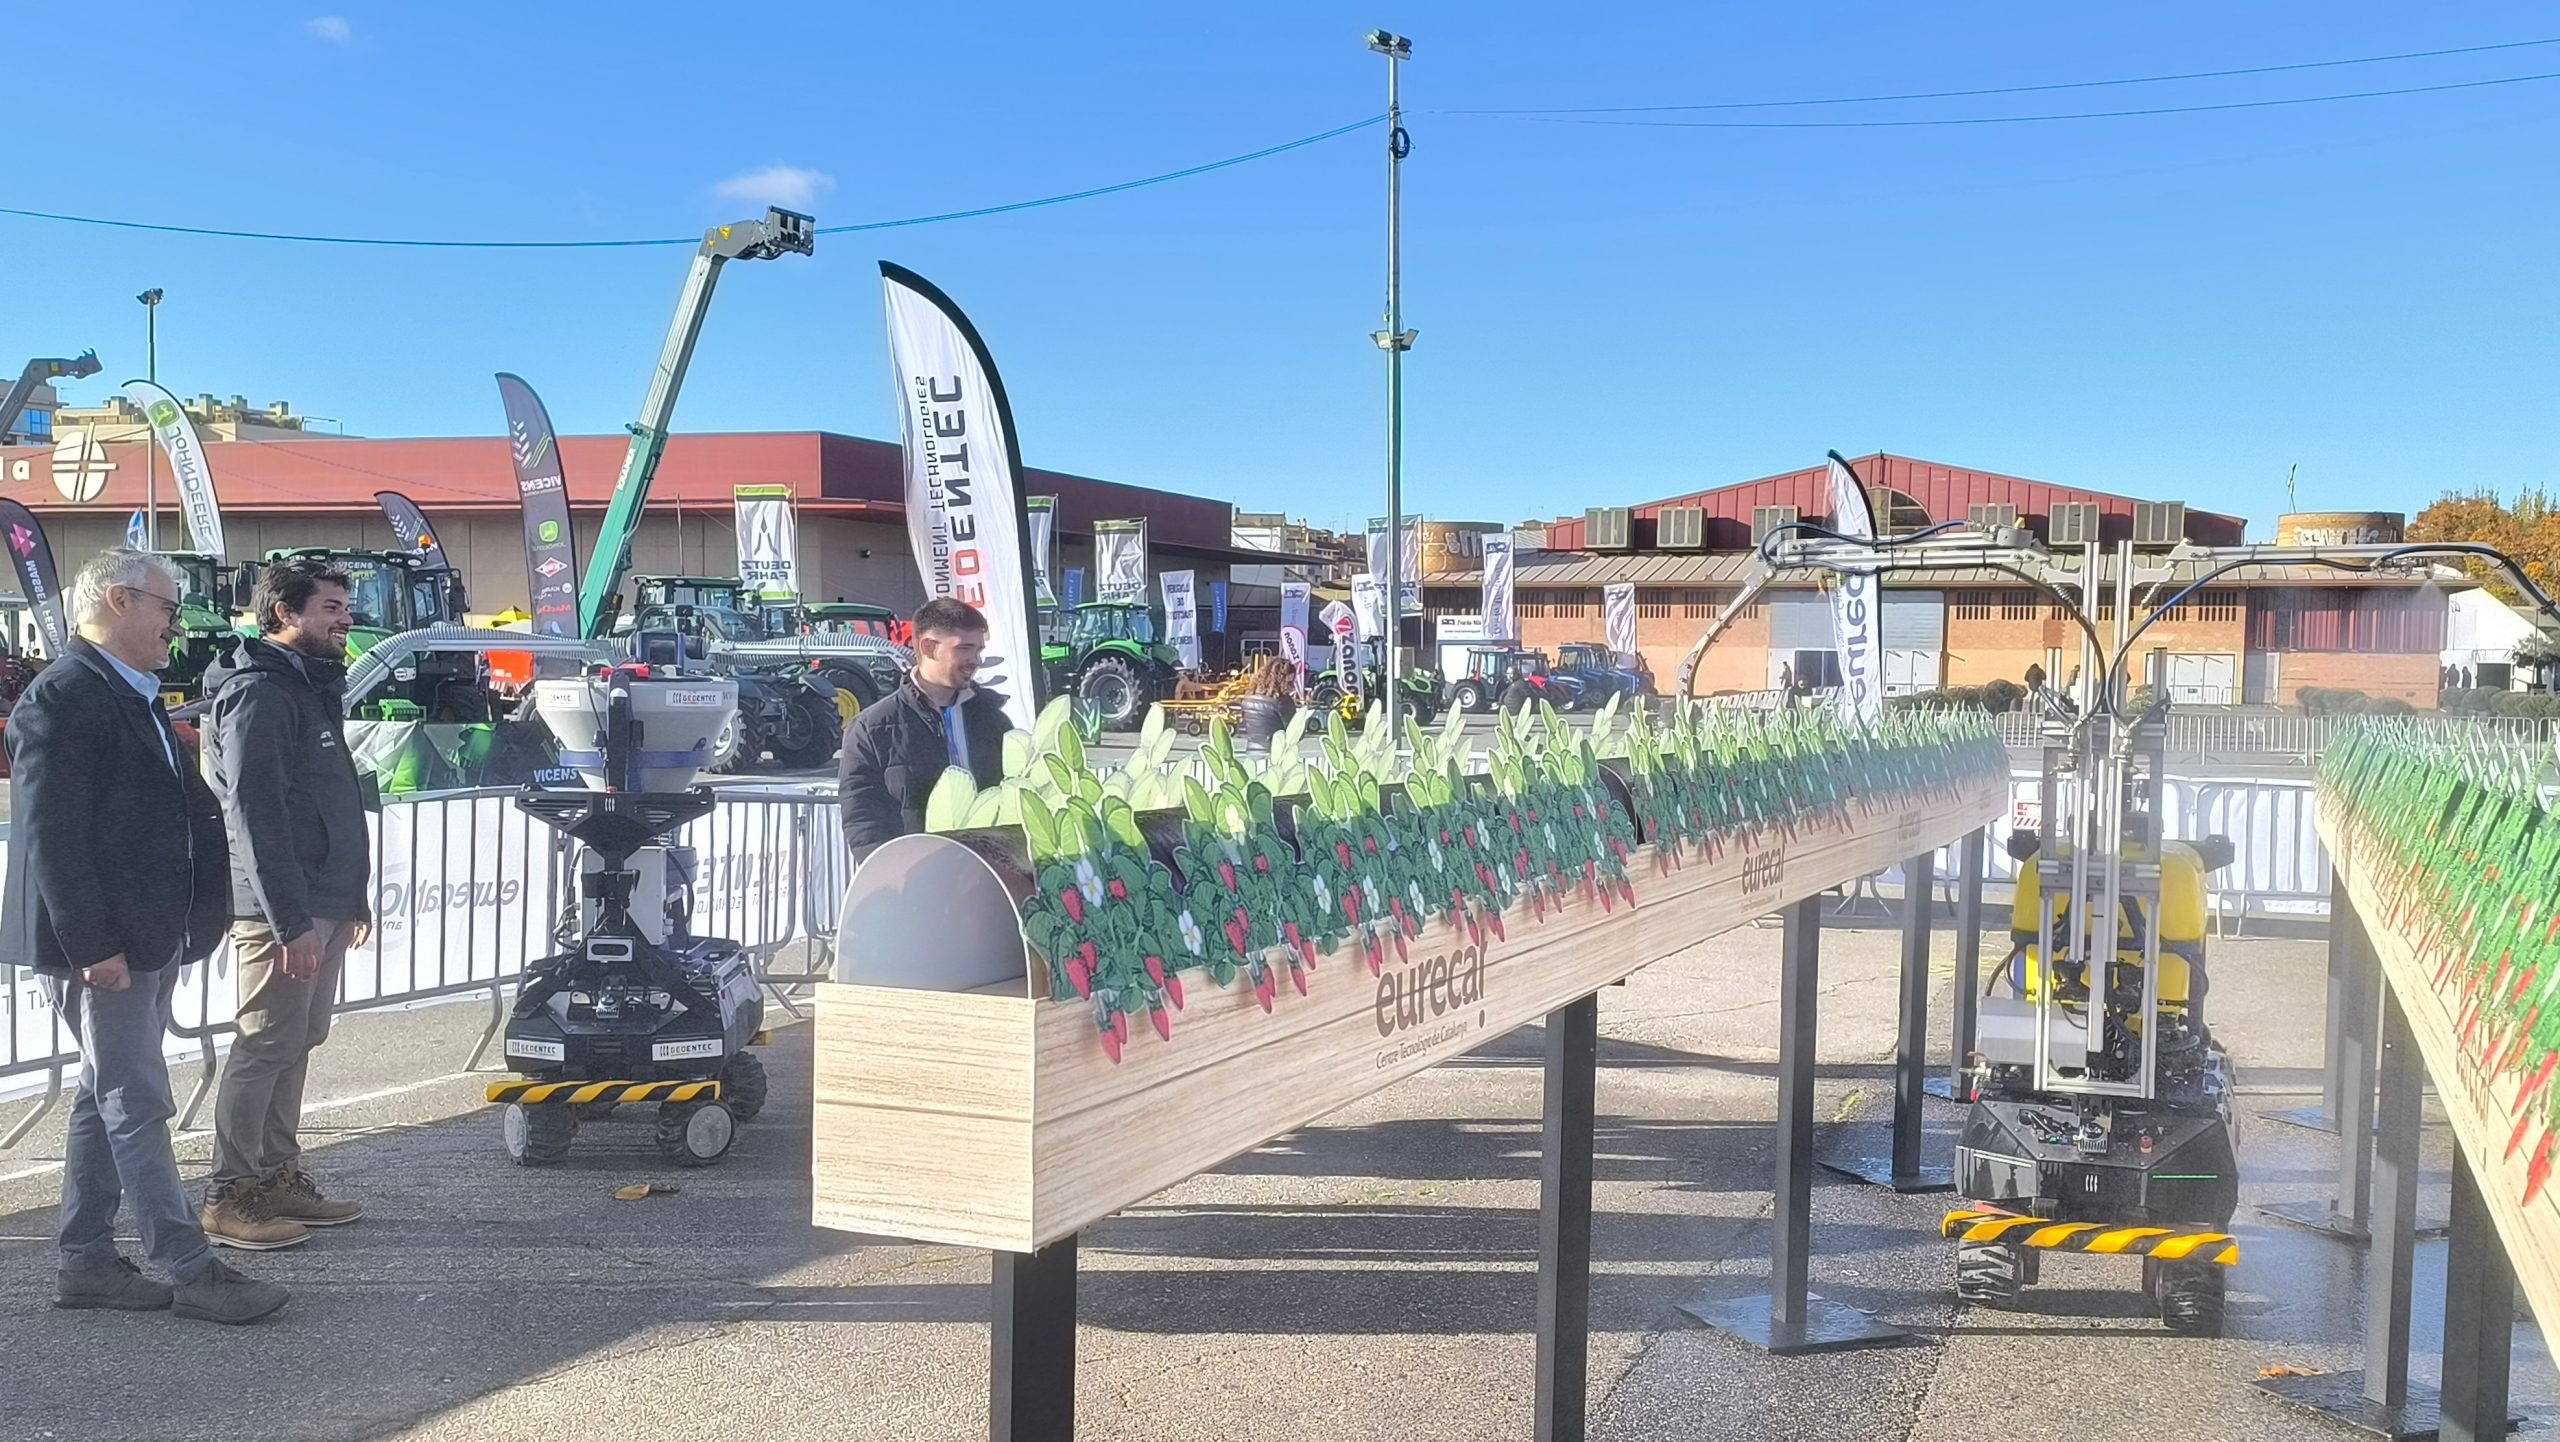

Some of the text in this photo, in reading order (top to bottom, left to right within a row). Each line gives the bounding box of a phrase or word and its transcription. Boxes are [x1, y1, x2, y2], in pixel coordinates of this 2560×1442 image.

[533, 767, 578, 783] VICENS
[1376, 928, 1488, 1038] eurecat
[670, 1043, 713, 1053] GEOENTEC
